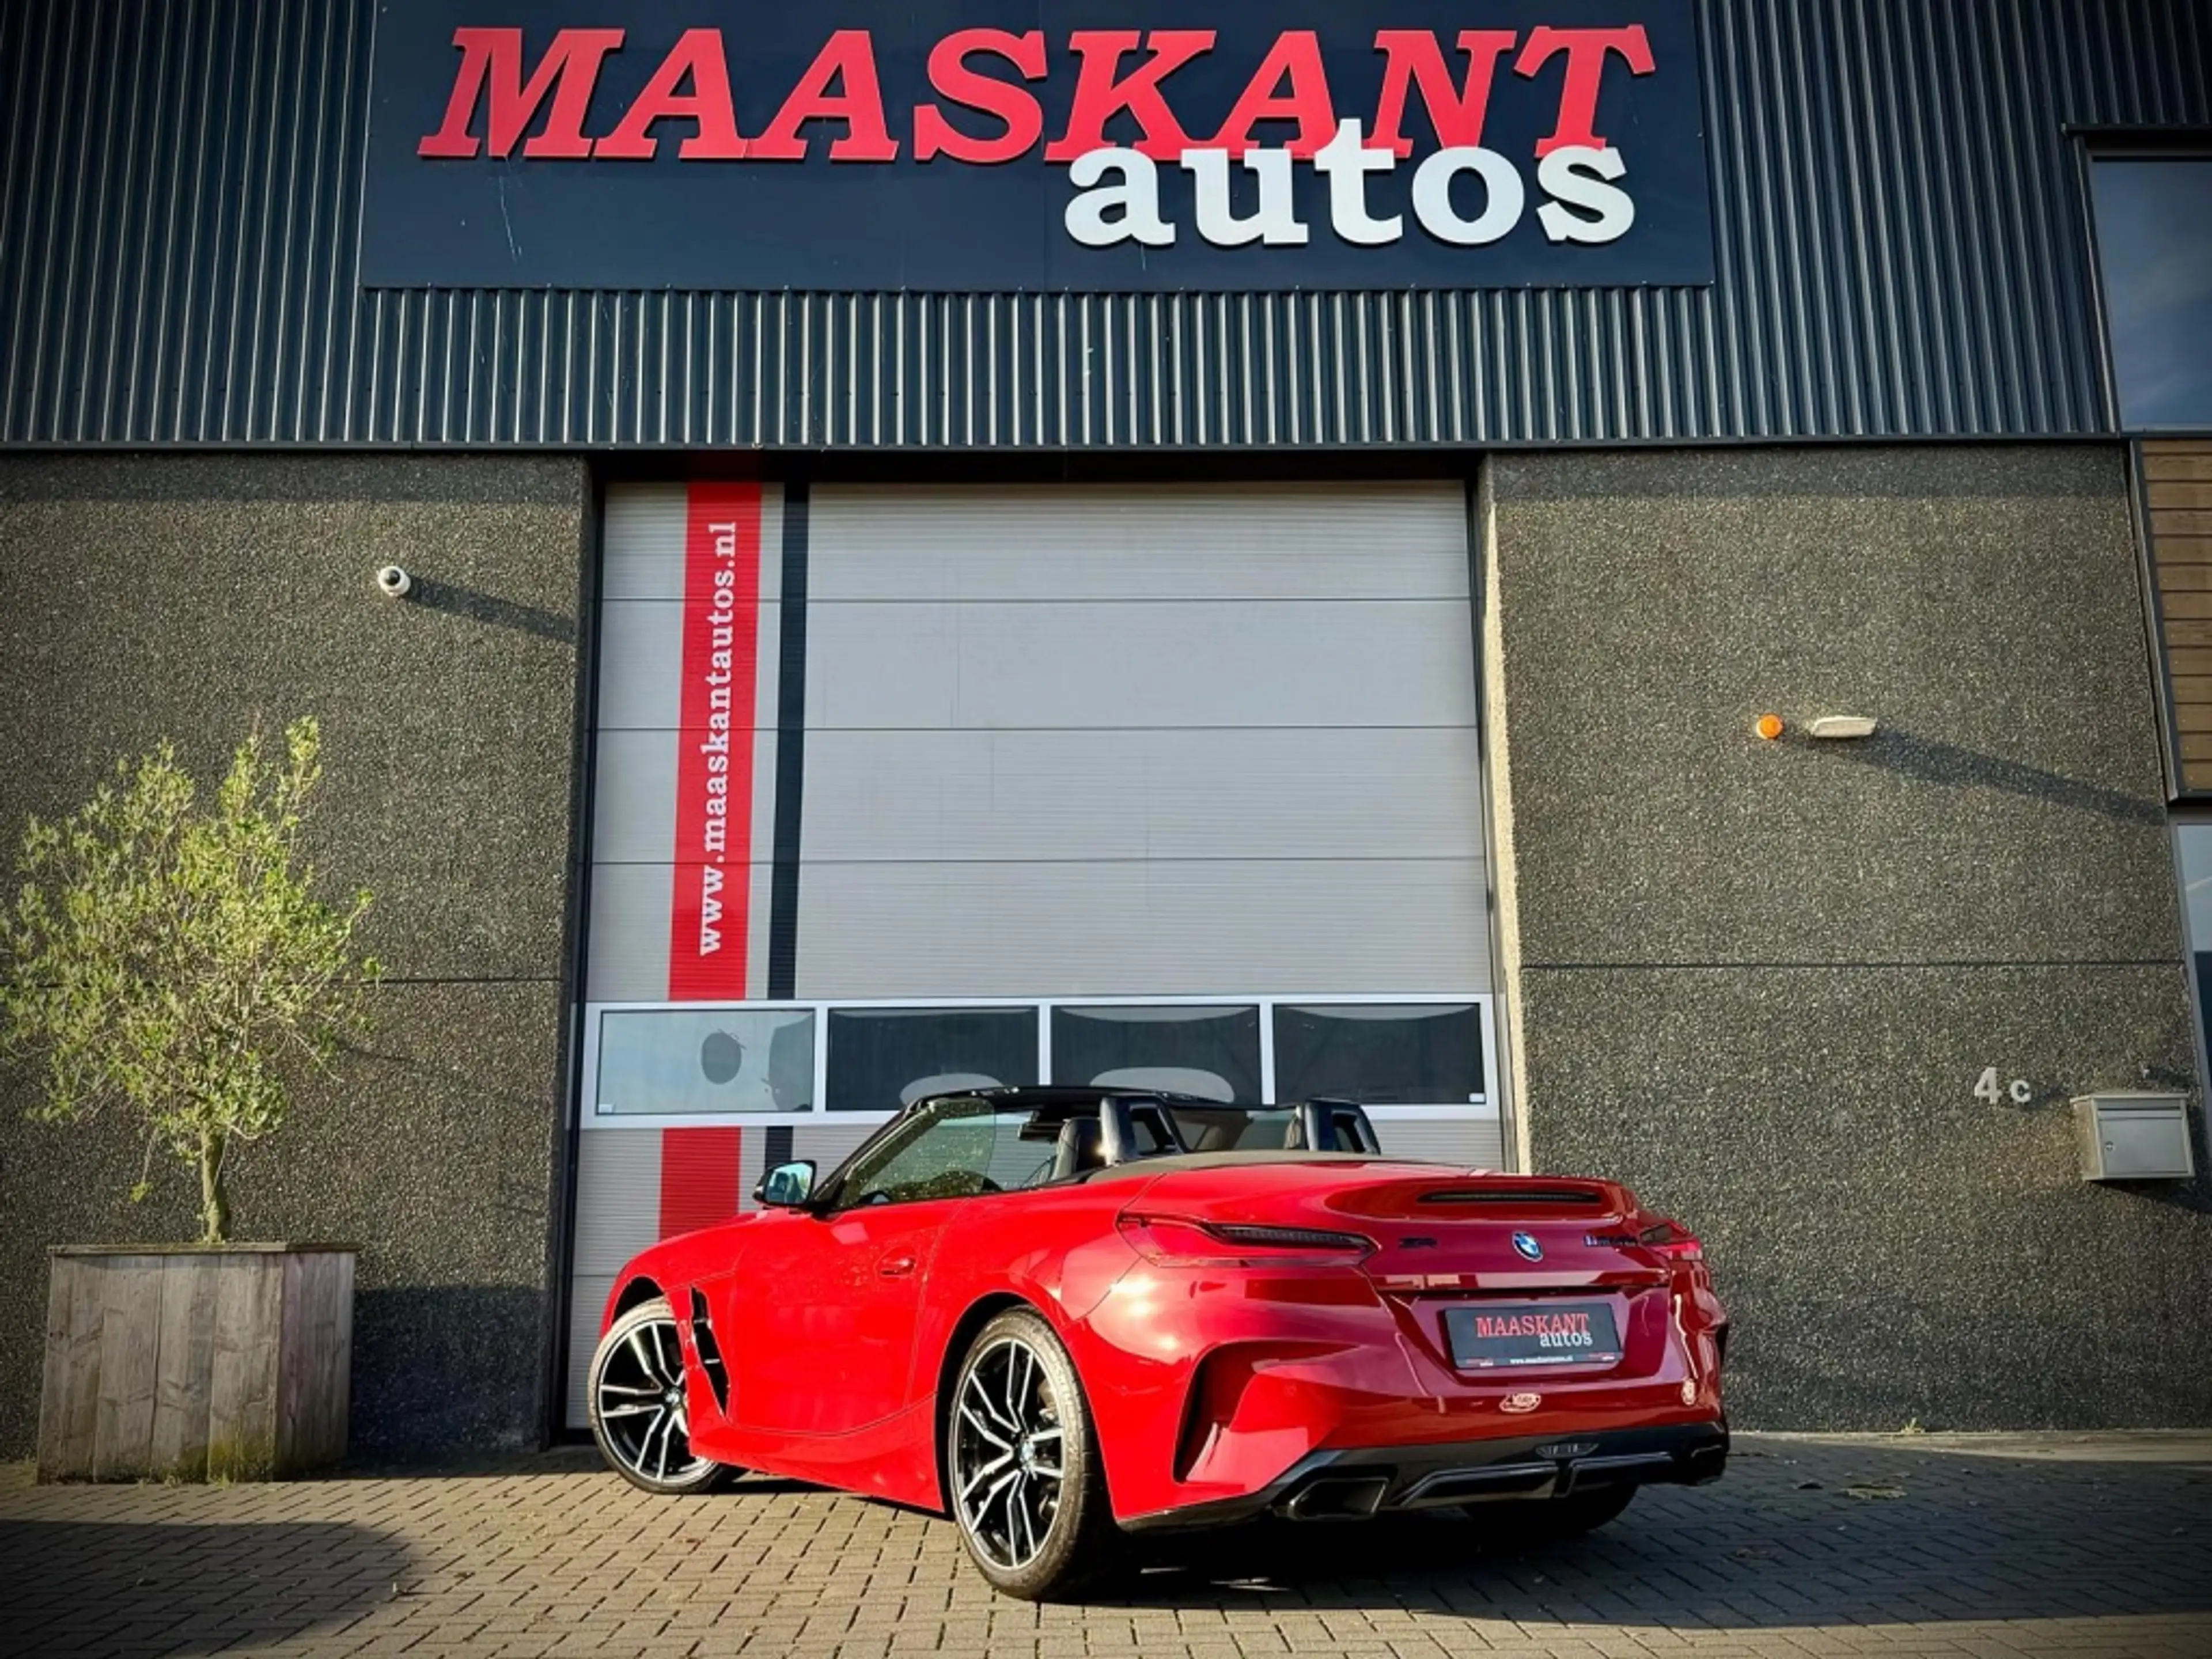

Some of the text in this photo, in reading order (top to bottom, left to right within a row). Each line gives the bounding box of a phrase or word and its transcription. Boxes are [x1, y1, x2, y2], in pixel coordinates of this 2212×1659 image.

[419, 24, 1656, 164] MAASKANT
[1065, 118, 1635, 247] autos
[699, 522, 736, 956] www.maaskantautos.nl
[1475, 1313, 1590, 1338] MAASKANT
[1539, 1331, 1593, 1348] autos
